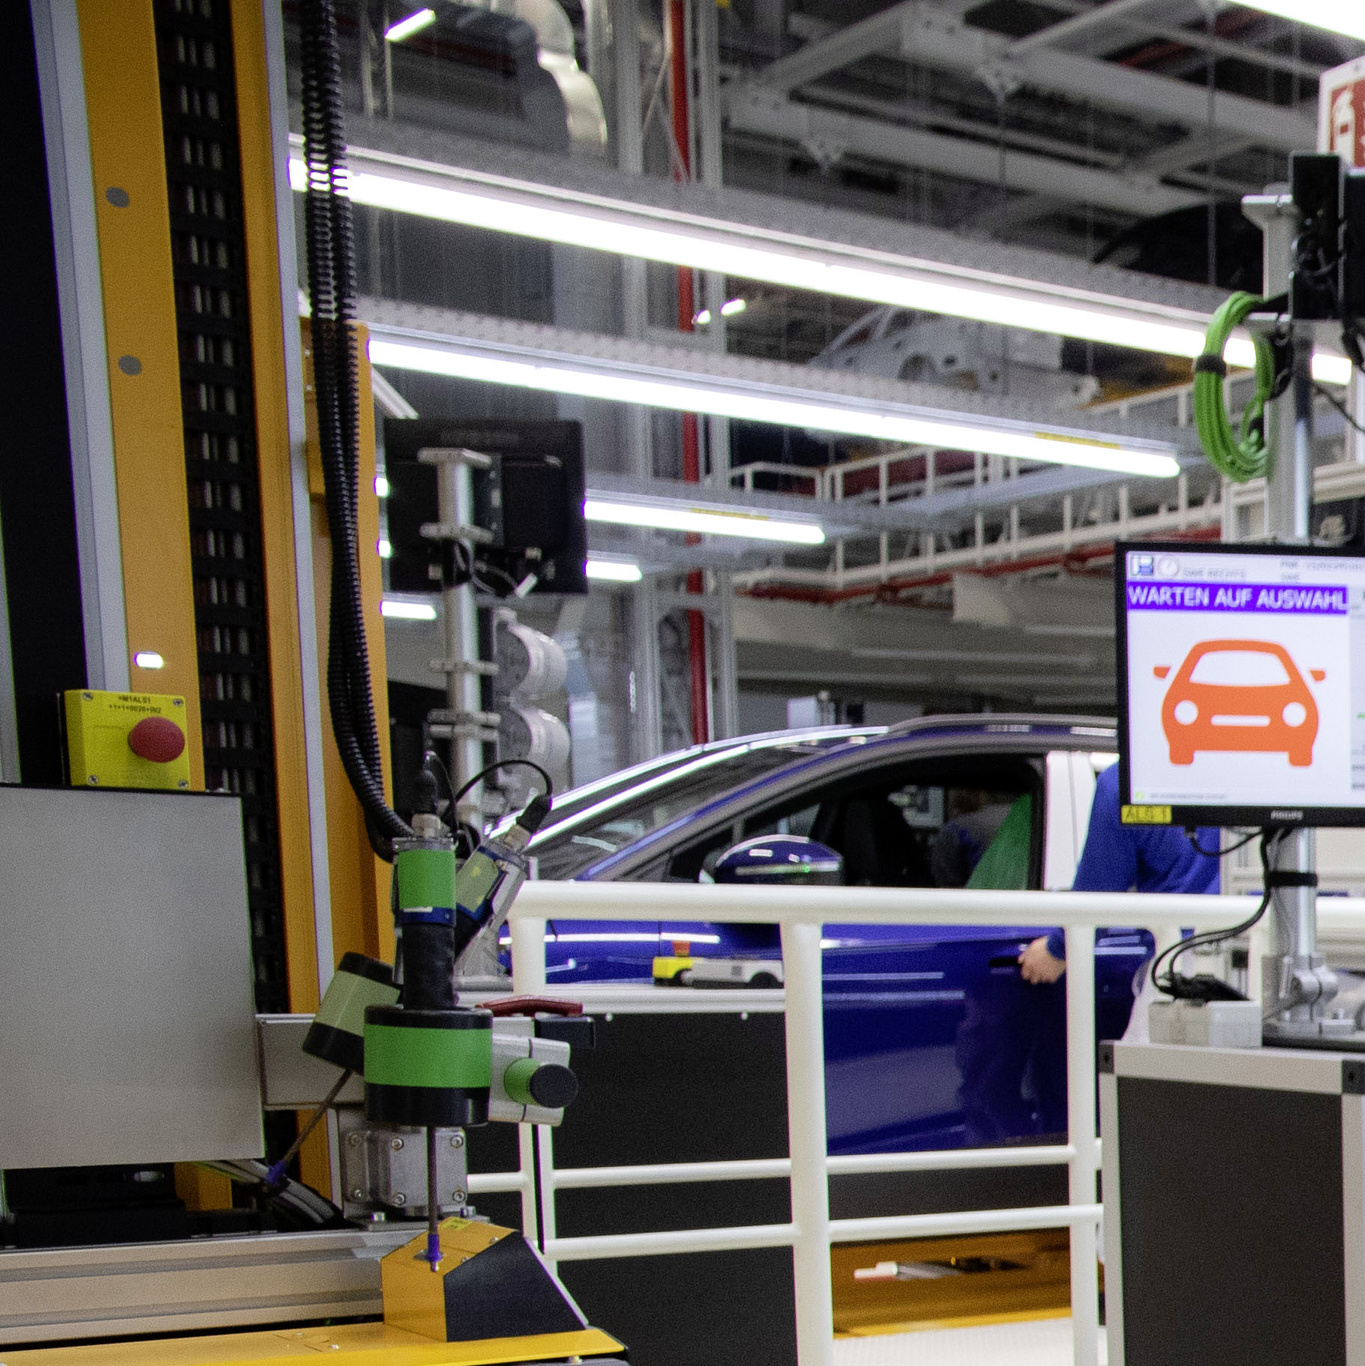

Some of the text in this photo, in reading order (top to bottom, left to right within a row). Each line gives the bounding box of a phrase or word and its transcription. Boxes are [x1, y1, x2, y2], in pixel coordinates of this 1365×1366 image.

[1129, 586, 1347, 611] WARTEN AUF AUSWAHL
